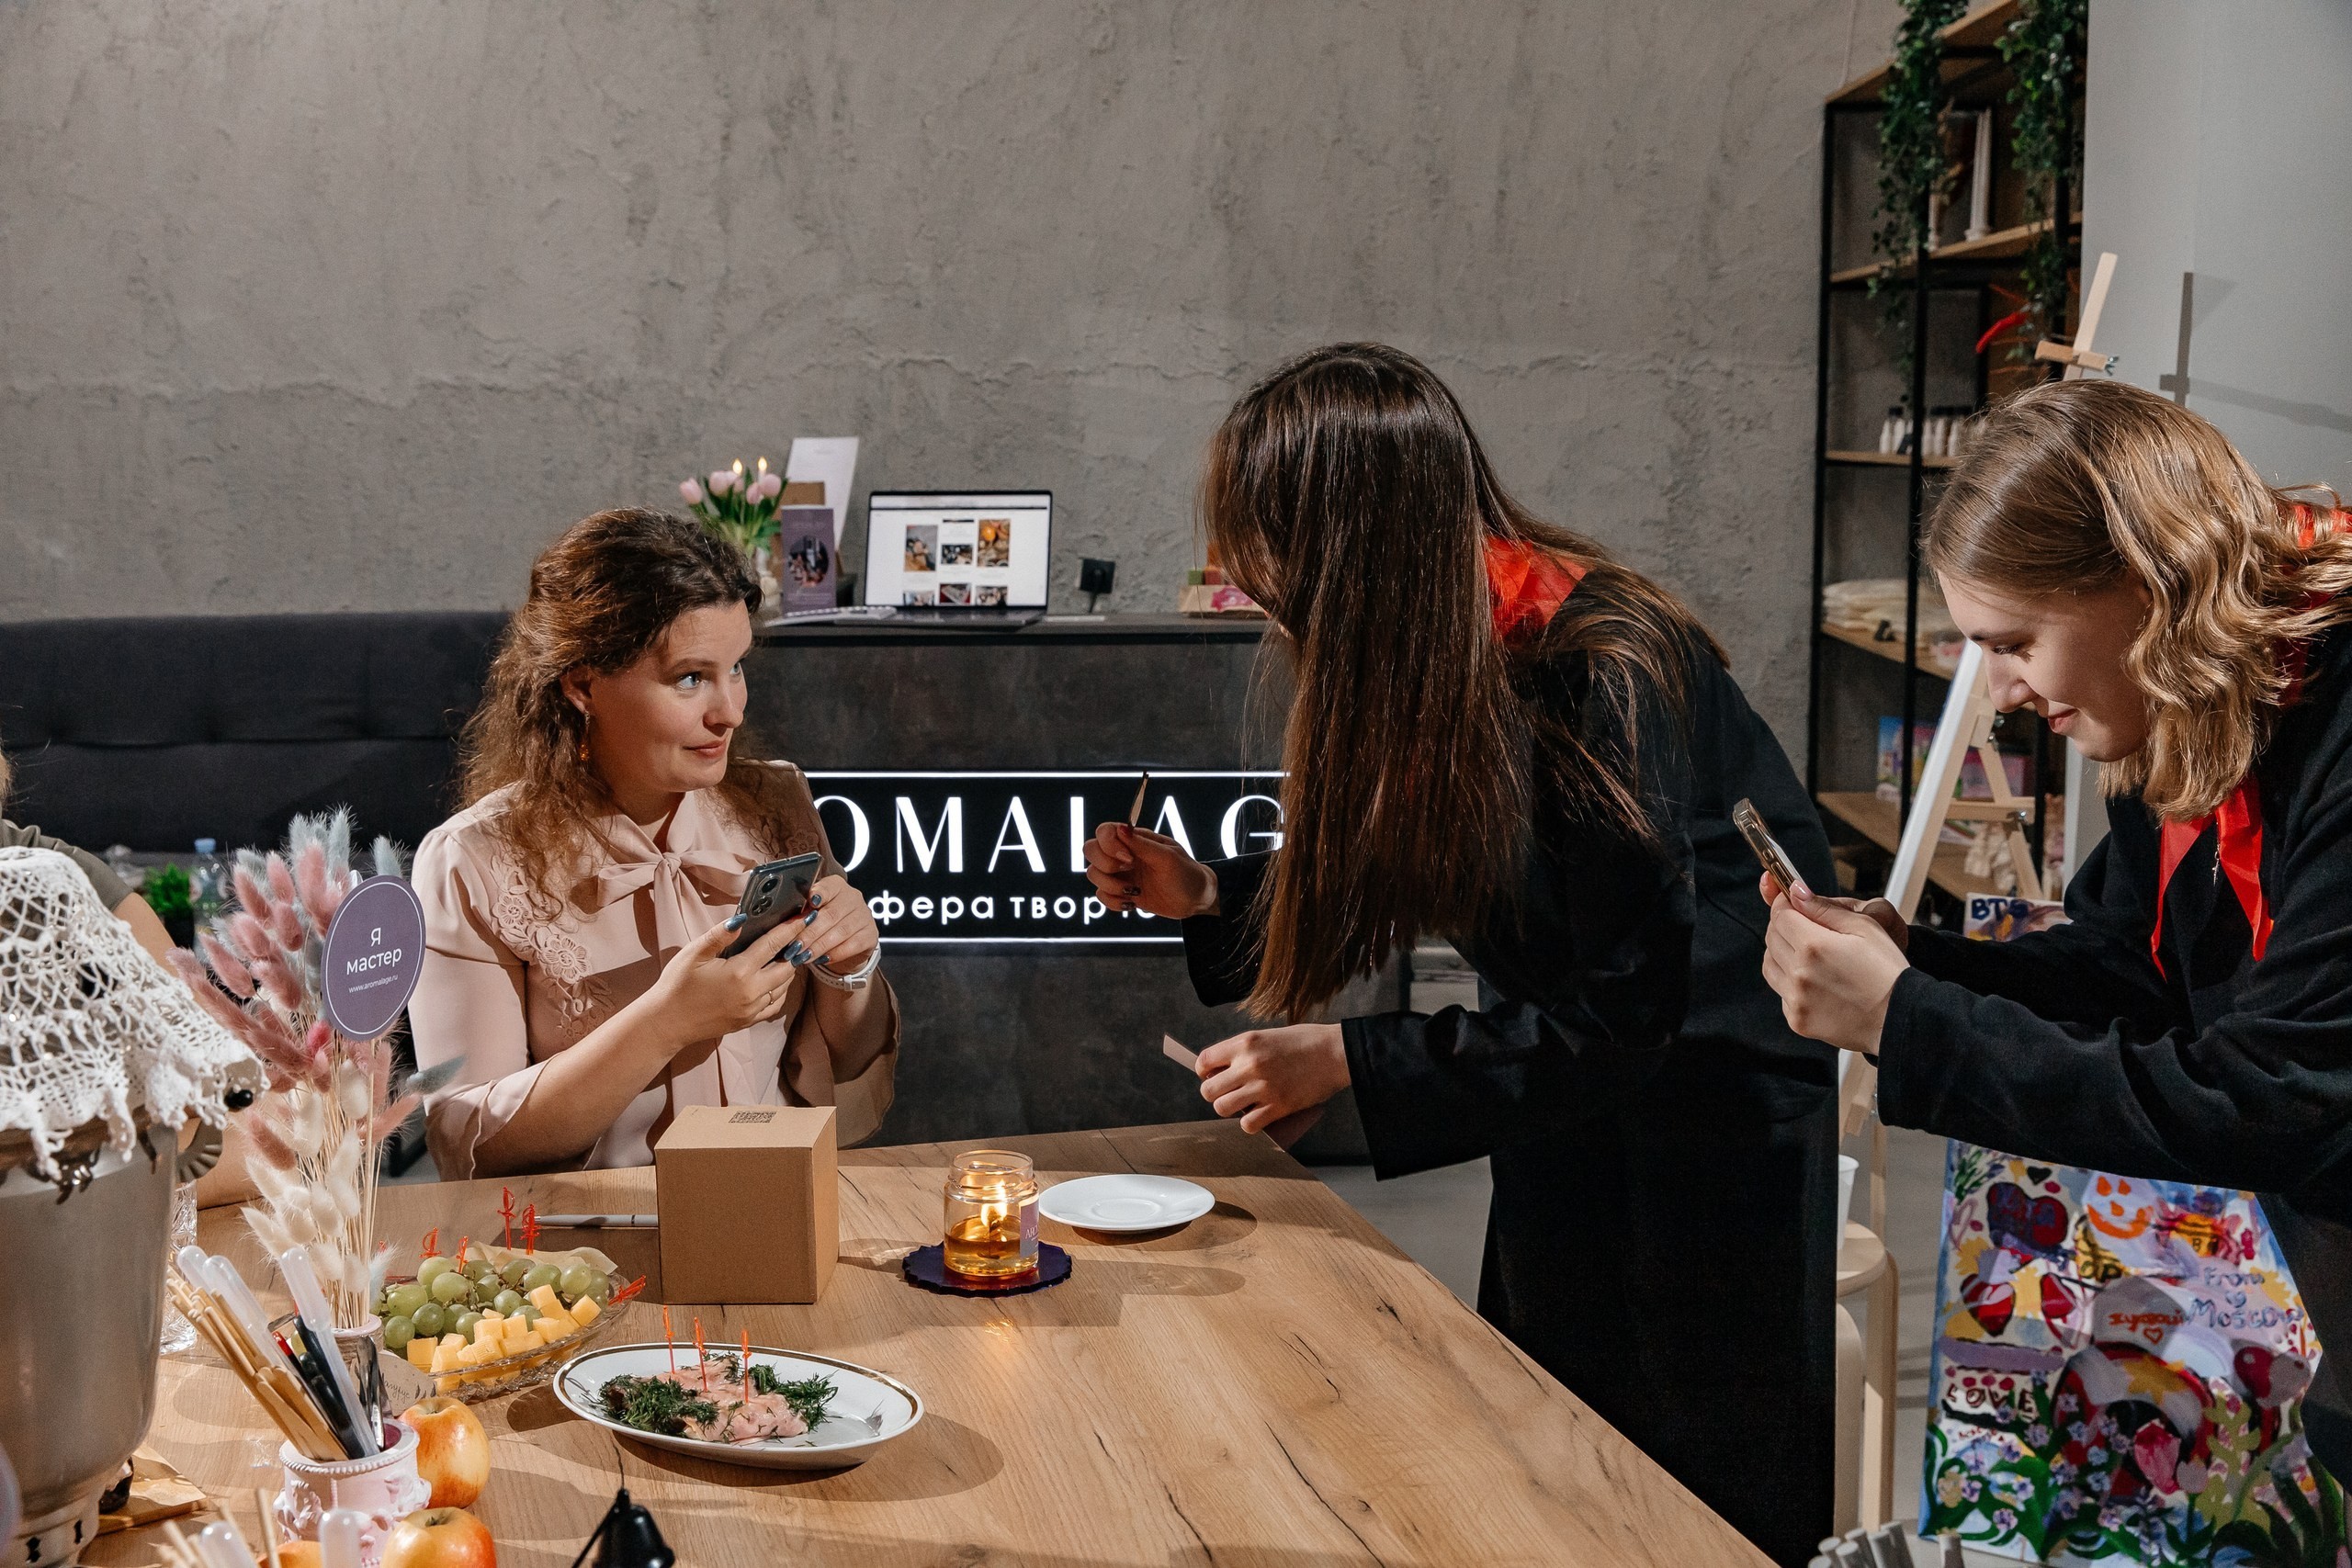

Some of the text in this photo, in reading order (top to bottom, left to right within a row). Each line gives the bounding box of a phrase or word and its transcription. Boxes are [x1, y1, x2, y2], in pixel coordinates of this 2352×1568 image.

[1009, 896, 1157, 925] твор
[370, 927, 381, 947] Я
[346, 948, 402, 976] мастер
[348, 975, 399, 993] www.aromalage.ru
